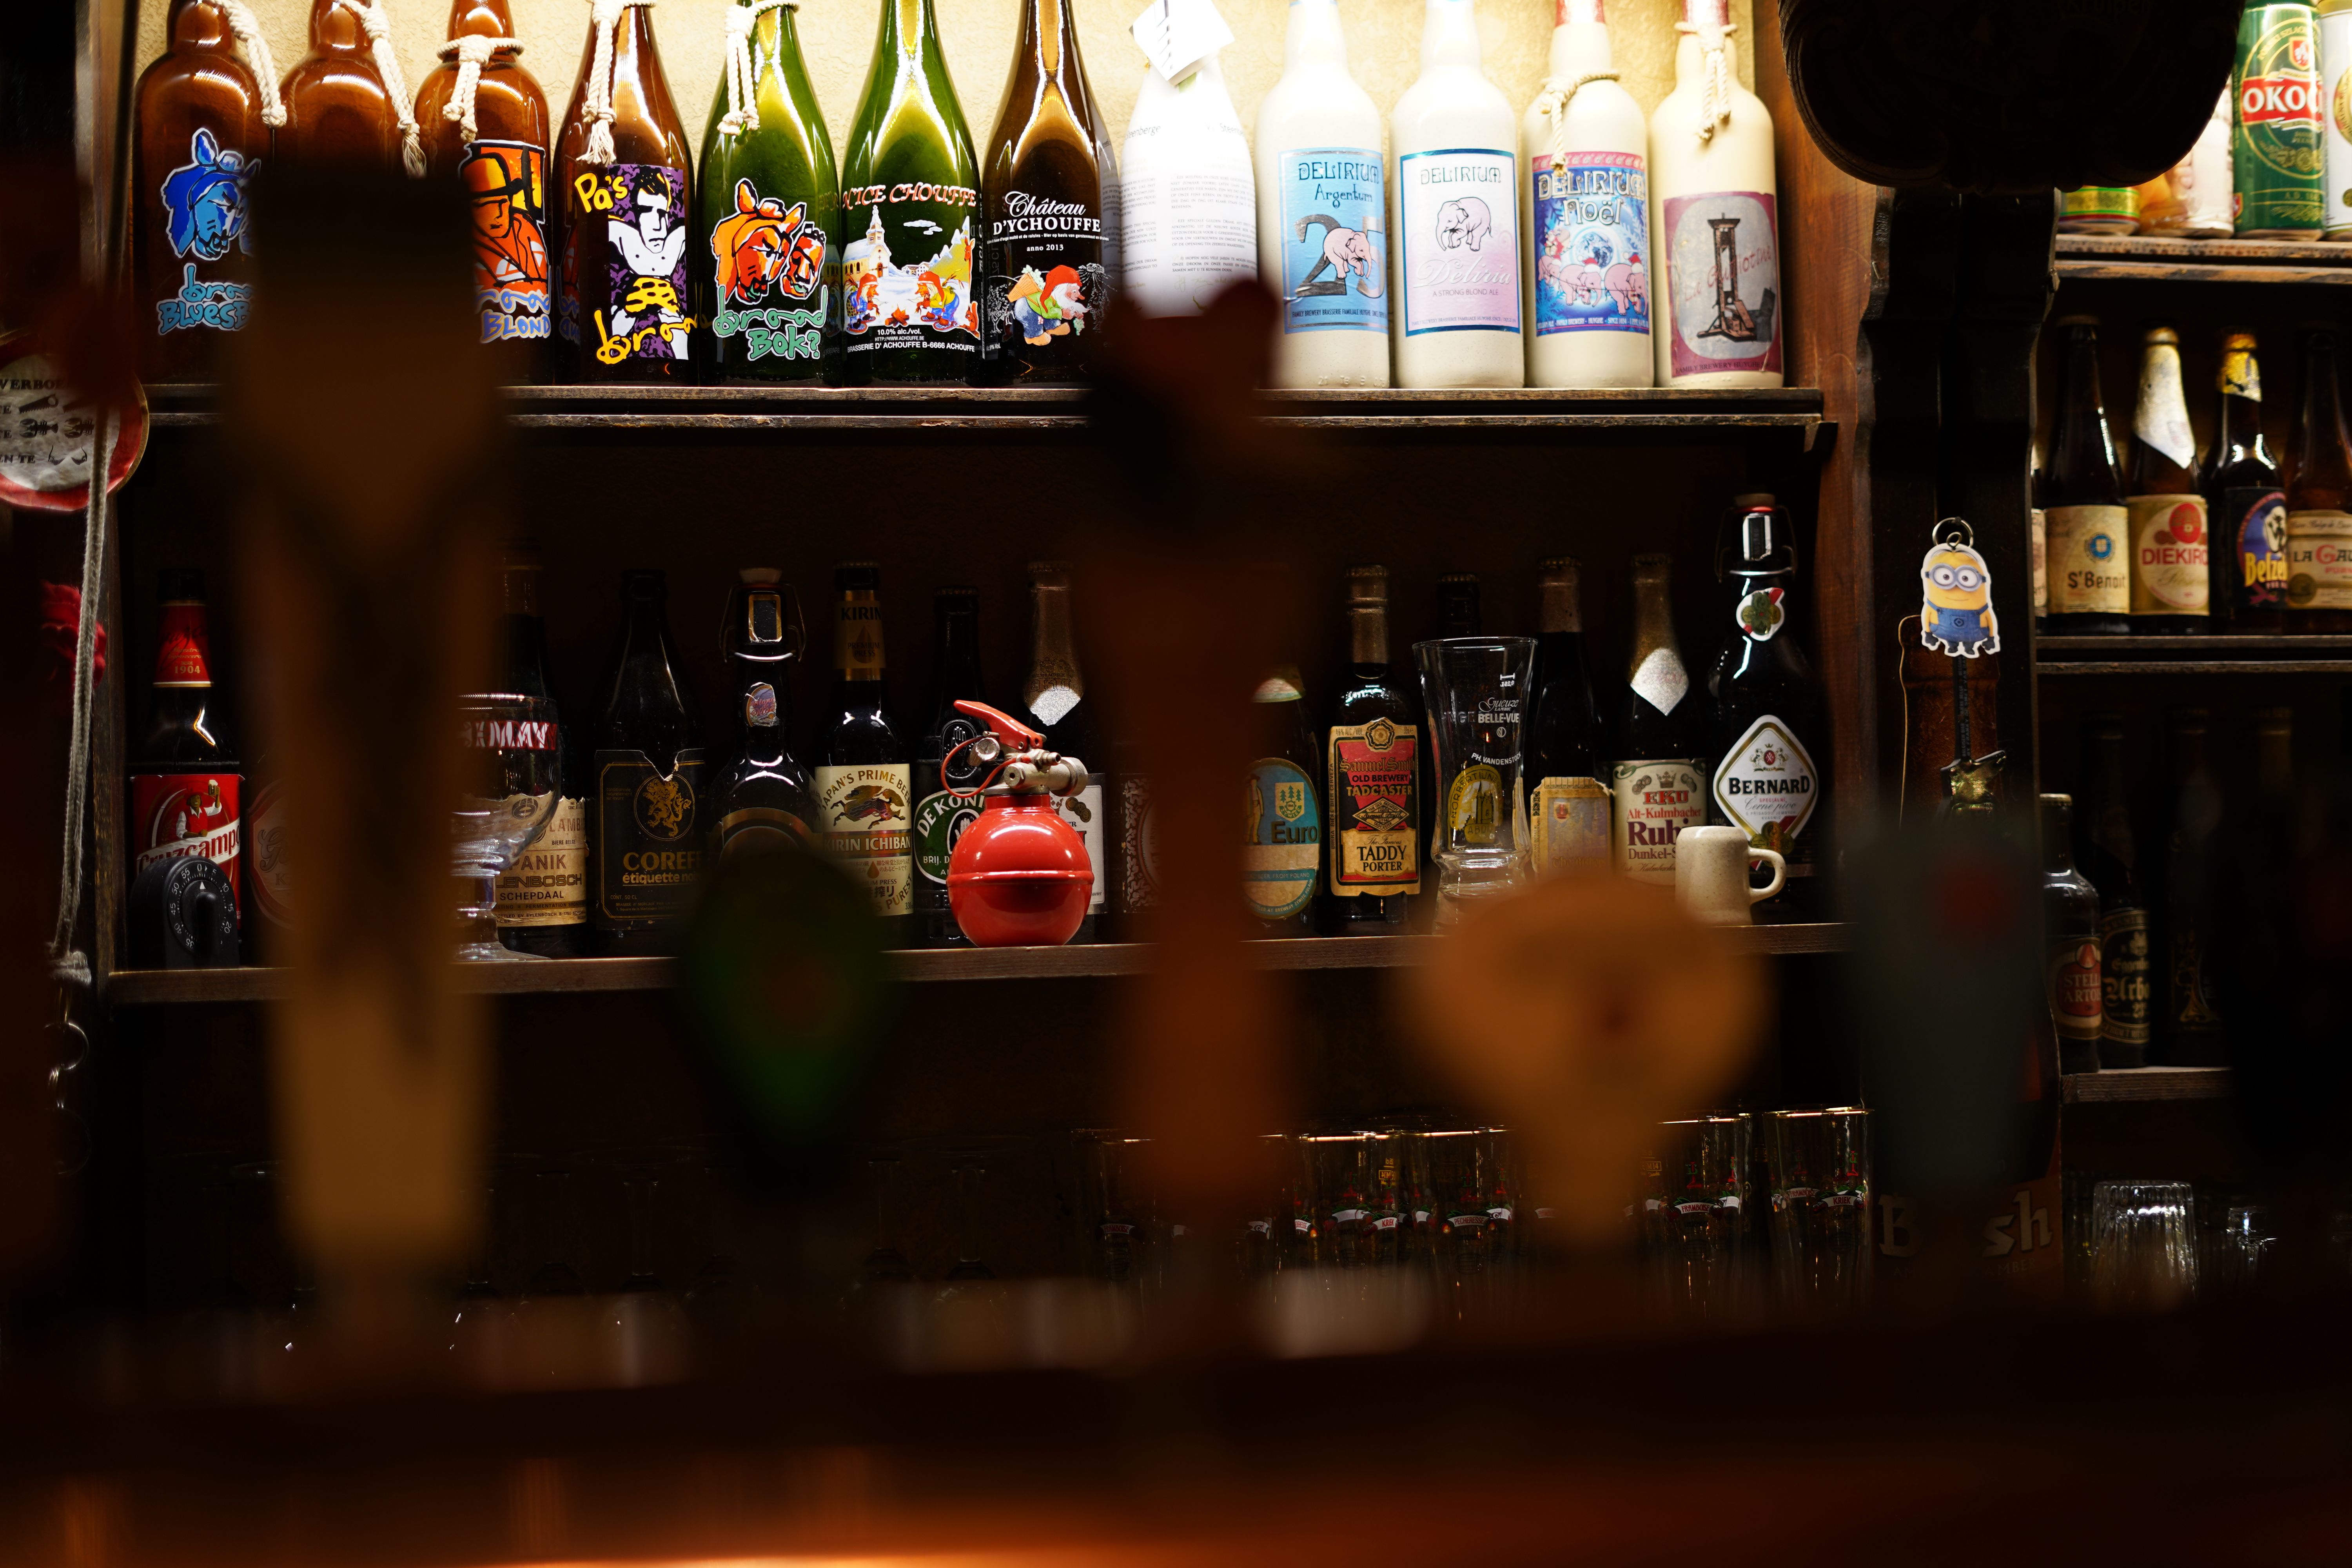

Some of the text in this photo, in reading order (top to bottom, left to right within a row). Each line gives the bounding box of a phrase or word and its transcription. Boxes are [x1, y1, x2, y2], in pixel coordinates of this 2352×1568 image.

[1298, 162, 1379, 184] DELIRIUM
[1421, 167, 1501, 185] DELIRIUM
[1538, 171, 1645, 200] DELIRIUM
[575, 172, 628, 213] Pa's
[842, 182, 977, 211] N'ICE CHOUFFE
[1314, 184, 1373, 209] Argentum
[1005, 191, 1087, 217] Château
[993, 217, 1101, 235] D'YCHOUFFE
[1413, 256, 1512, 288] Deliria
[848, 343, 874, 353] BRASSERIE
[946, 343, 975, 352] ACHOUFFE
[1675, 365, 1698, 374] FAMILY
[2143, 549, 2210, 565] DIEKIRC
[2294, 552, 2312, 561] LA
[841, 607, 882, 620] KIRIN
[1478, 713, 1519, 724] BELLE-VUE
[1340, 757, 1386, 772] Samuel
[1483, 751, 1521, 765] VANDENSTOCK
[822, 769, 910, 810] JAPAN'S PRIME BEER
[1347, 784, 1412, 796] TADCASTER
[1728, 775, 1810, 795] BERNARD
[1643, 791, 1688, 804] EKU
[1627, 807, 1701, 819] Alt-Kulmbacher
[917, 808, 936, 838] DE
[1271, 821, 1318, 843] Euro
[825, 836, 910, 852] KIRIN ICHIBAN
[1364, 834, 1402, 845] The Famous
[1357, 845, 1406, 861] TADDY
[181, 868, 190, 878] 55
[1363, 862, 1402, 872] PORTER
[622, 873, 680, 884] étiquette
[172, 883, 180, 895] 50
[222, 883, 229, 892] 10
[886, 874, 912, 909] PUREST
[500, 891, 564, 900] SCHEPDAAL
[170, 903, 176, 915] 45
[228, 903, 234, 911] 15
[174, 924, 181, 934] 40
[224, 921, 232, 933] 20
[2064, 973, 2101, 987] STELL
[1833, 1196, 1851, 1205] KRIEK
[1682, 1204, 1710, 1212] FRAMBOISE
[1103, 1225, 1129, 1233] FRAMBOISE
[1878, 1190, 2053, 1258] Bsh
[1985, 1258, 2036, 1276] AMBER
